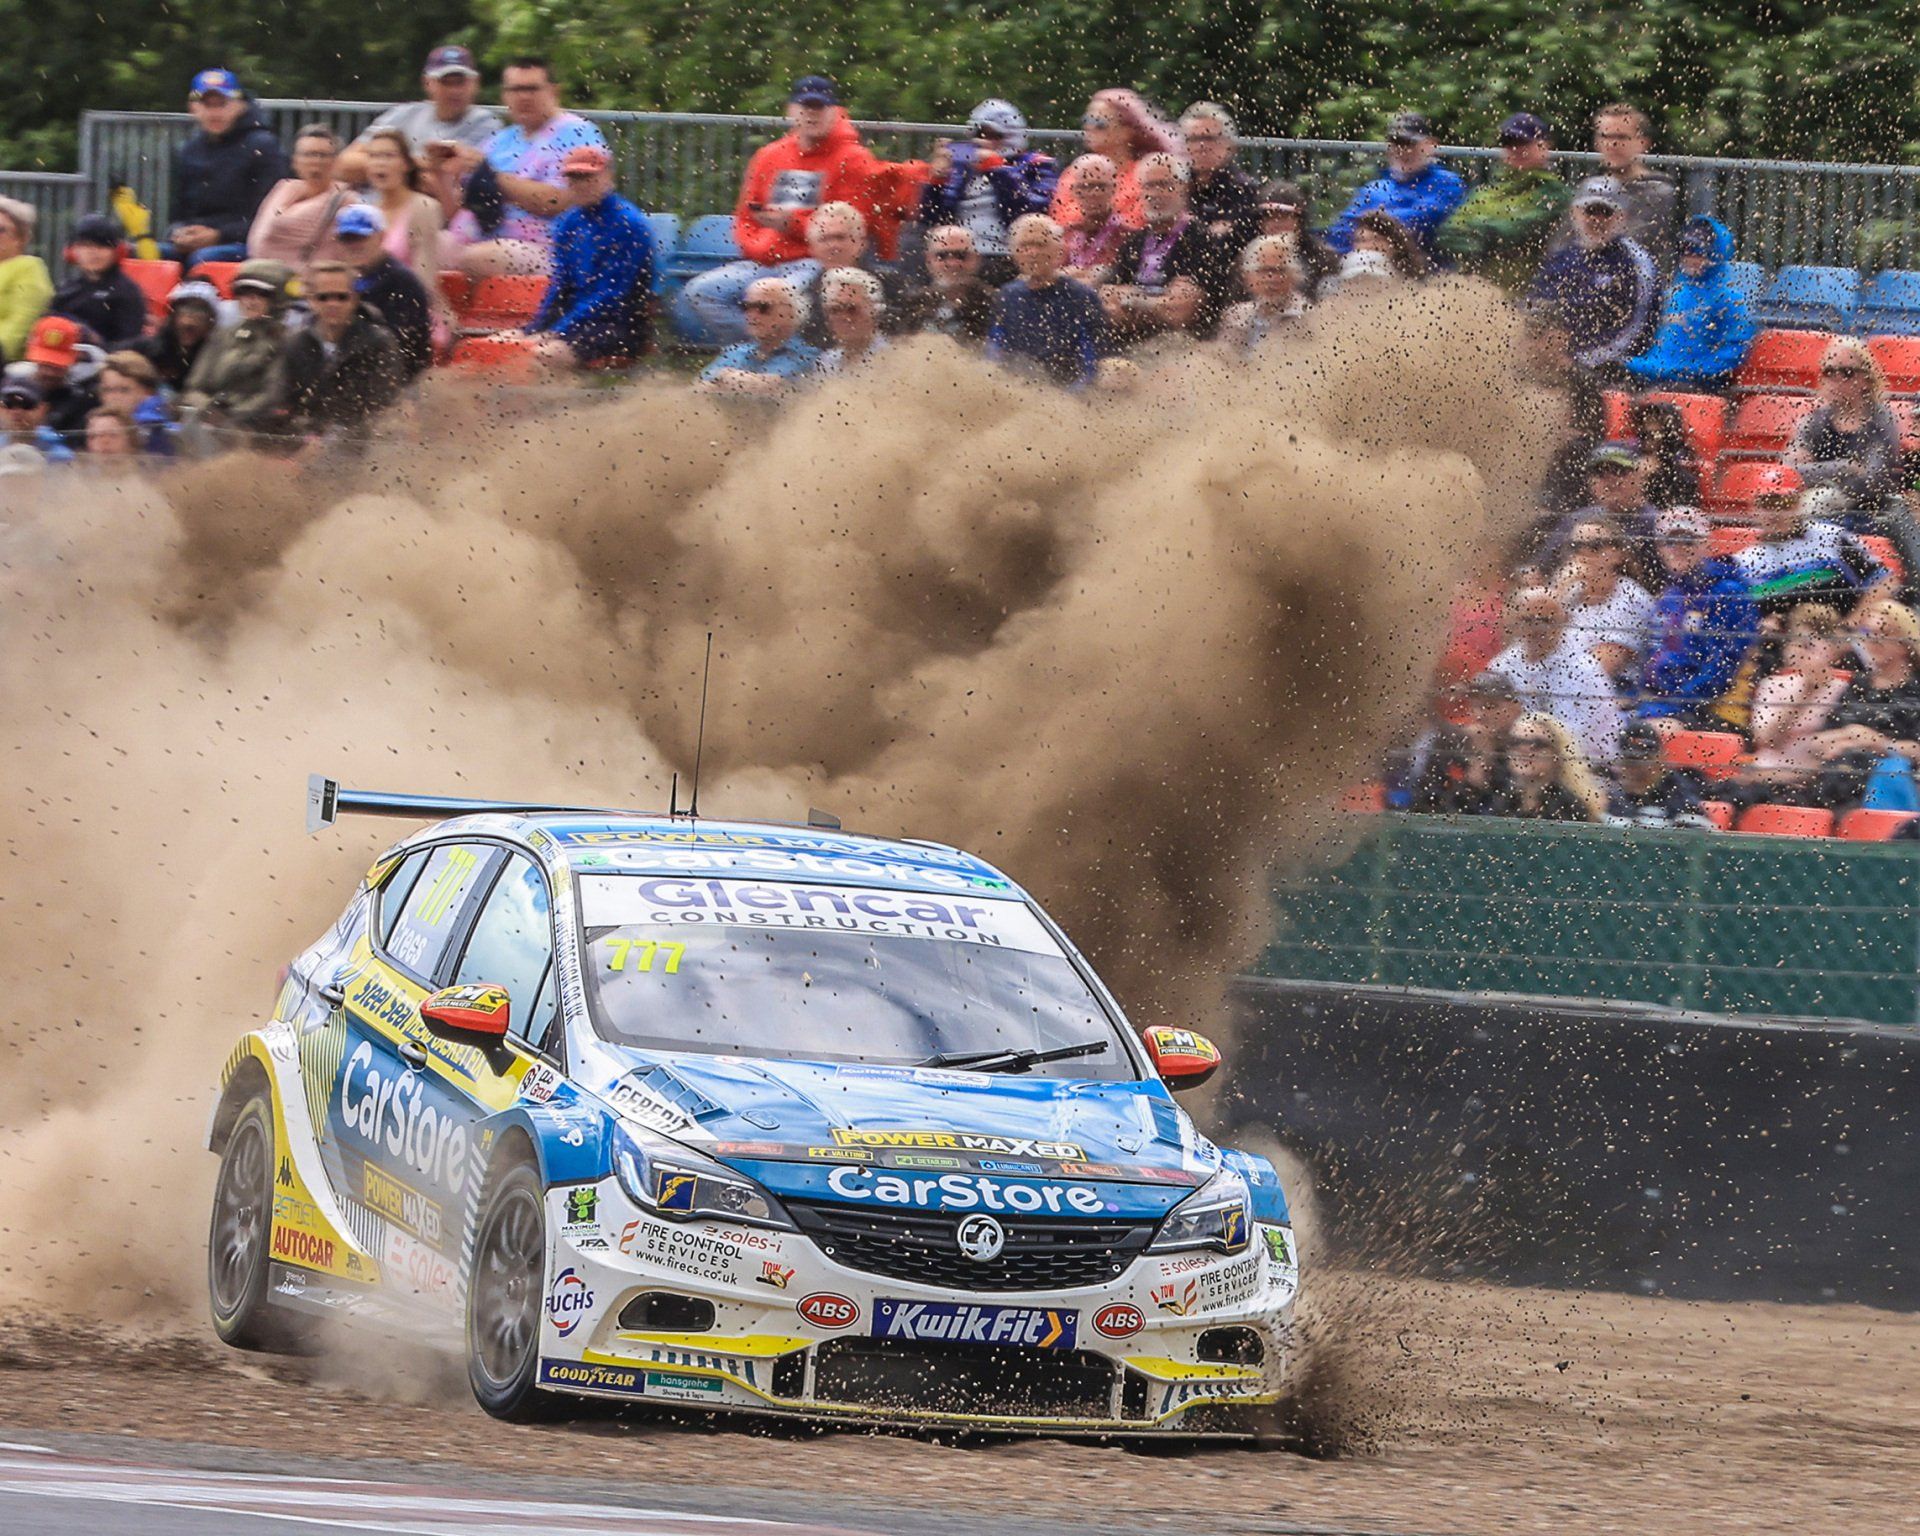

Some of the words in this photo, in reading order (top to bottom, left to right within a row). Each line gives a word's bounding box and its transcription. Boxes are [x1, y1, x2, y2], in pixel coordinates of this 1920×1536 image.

[601, 846, 968, 888] CarStore
[638, 879, 986, 928] Glencar
[650, 911, 1001, 946] CONSTRUCTION
[606, 939, 686, 974] 777
[341, 1040, 466, 1194] CarStore
[840, 1129, 959, 1148] POWER
[961, 1135, 1079, 1158] MAXED
[828, 1166, 1105, 1213] CarStore
[366, 1170, 403, 1218] POWER
[403, 1191, 441, 1243] MAXED
[273, 1226, 334, 1268] AUTOCAR
[576, 1238, 609, 1248] JFA
[641, 1222, 670, 1239] FIRE
[672, 1230, 743, 1260] CONTROL
[648, 1239, 730, 1269] SERVICES
[719, 1229, 782, 1253] sales-i
[635, 1249, 739, 1285] www.firecs.co.uk
[1200, 1270, 1221, 1286] FIRE
[1209, 1272, 1258, 1297] SERVICES
[545, 1291, 595, 1313] FUCHS
[807, 1300, 852, 1320] ABS
[1100, 1311, 1139, 1329] ABS
[660, 1374, 709, 1388] hansgrohe
